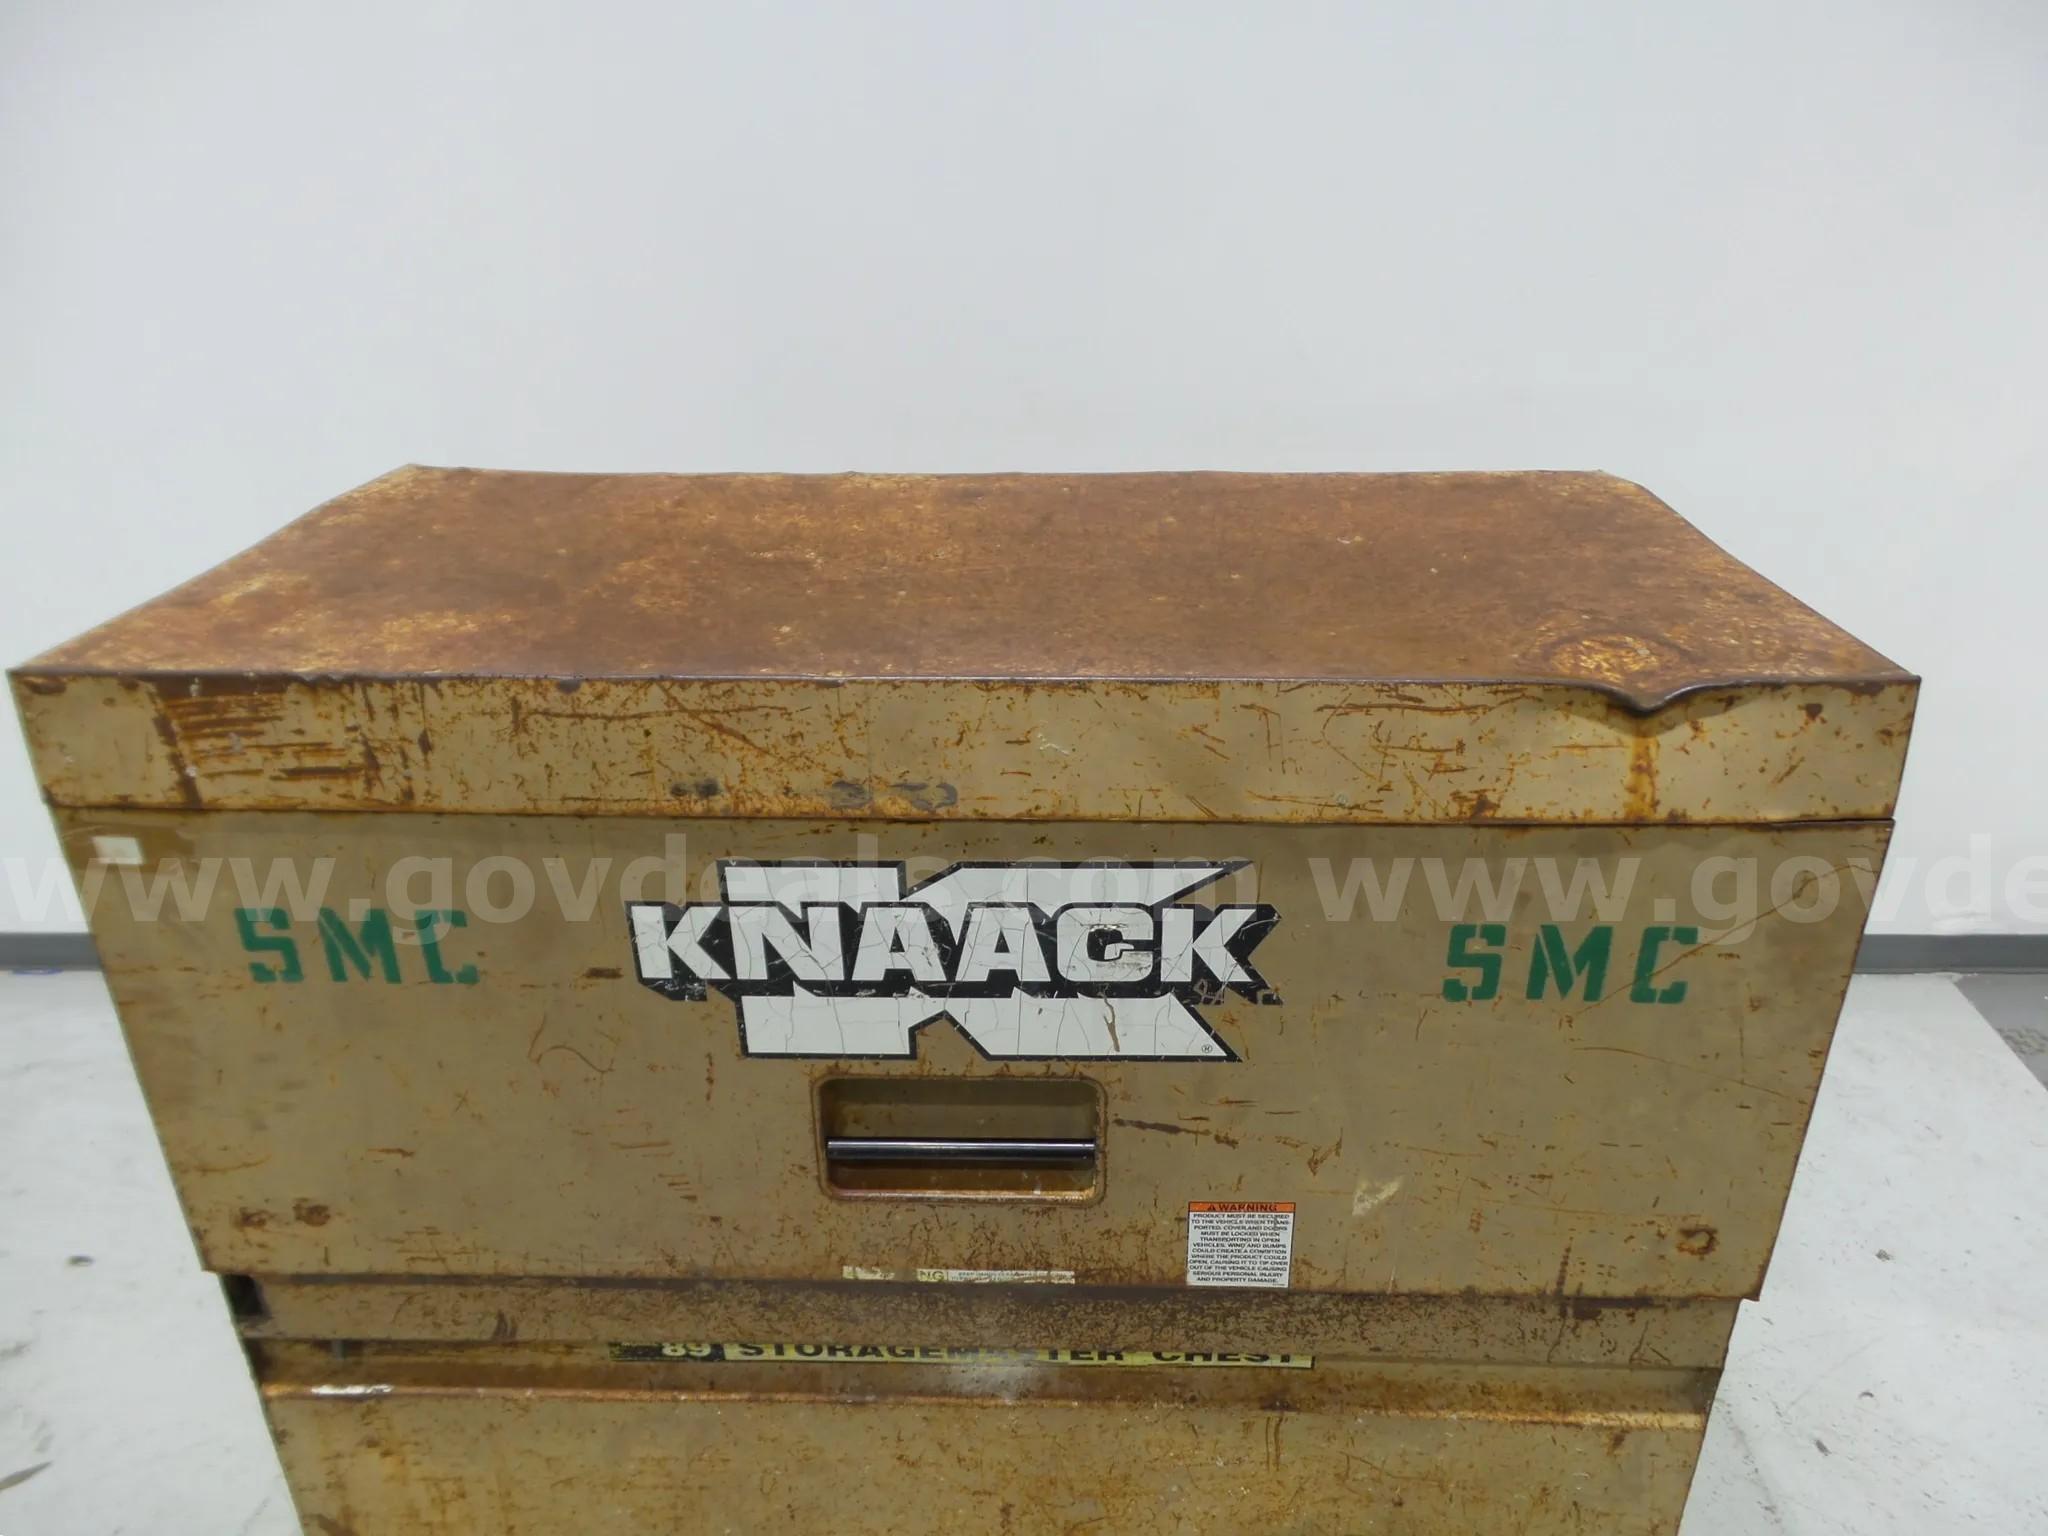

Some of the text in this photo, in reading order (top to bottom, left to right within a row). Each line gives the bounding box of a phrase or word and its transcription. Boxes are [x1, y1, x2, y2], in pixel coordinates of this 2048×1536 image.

[234, 907, 480, 984] SMC
[631, 903, 1256, 985] KNAACK
[1442, 923, 1699, 1005] SMC
